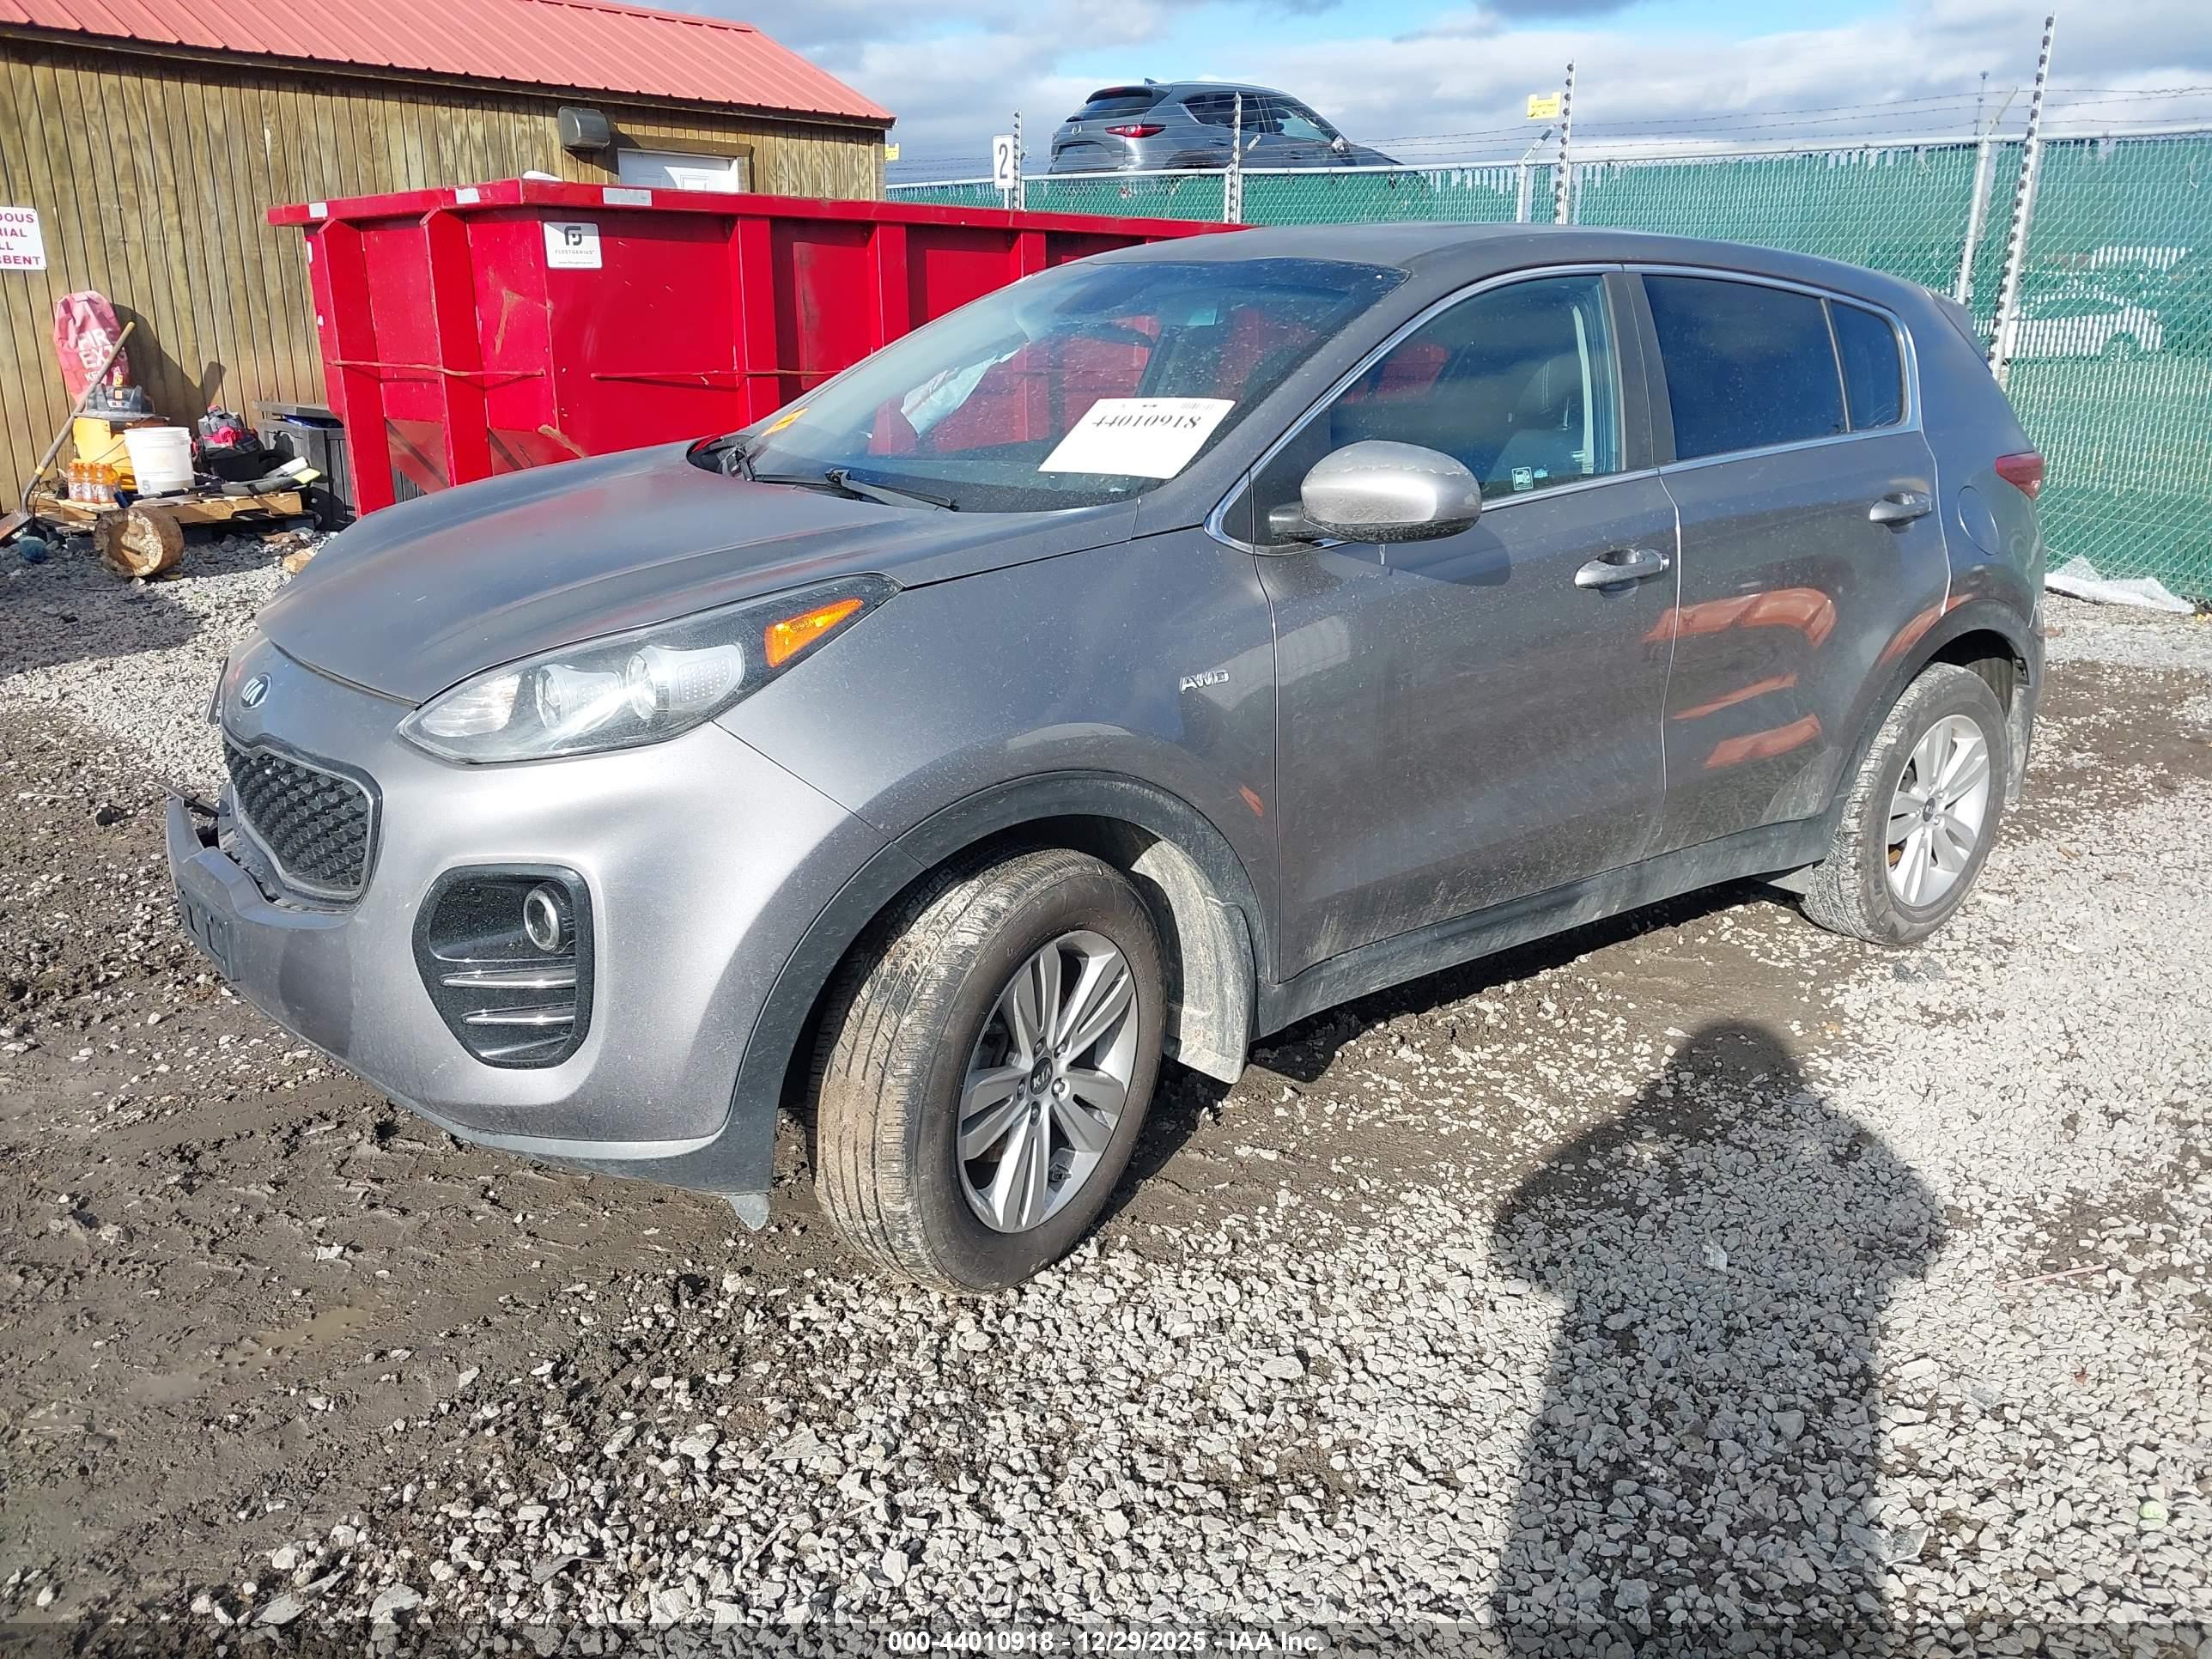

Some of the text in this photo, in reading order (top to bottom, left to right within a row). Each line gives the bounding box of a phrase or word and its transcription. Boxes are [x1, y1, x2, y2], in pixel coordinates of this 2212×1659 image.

[999, 143, 1008, 179] 2
[1092, 414, 1201, 428] 44010918
[1179, 670, 1229, 694] AWD
[1033, 1064, 1051, 1089] KIA
